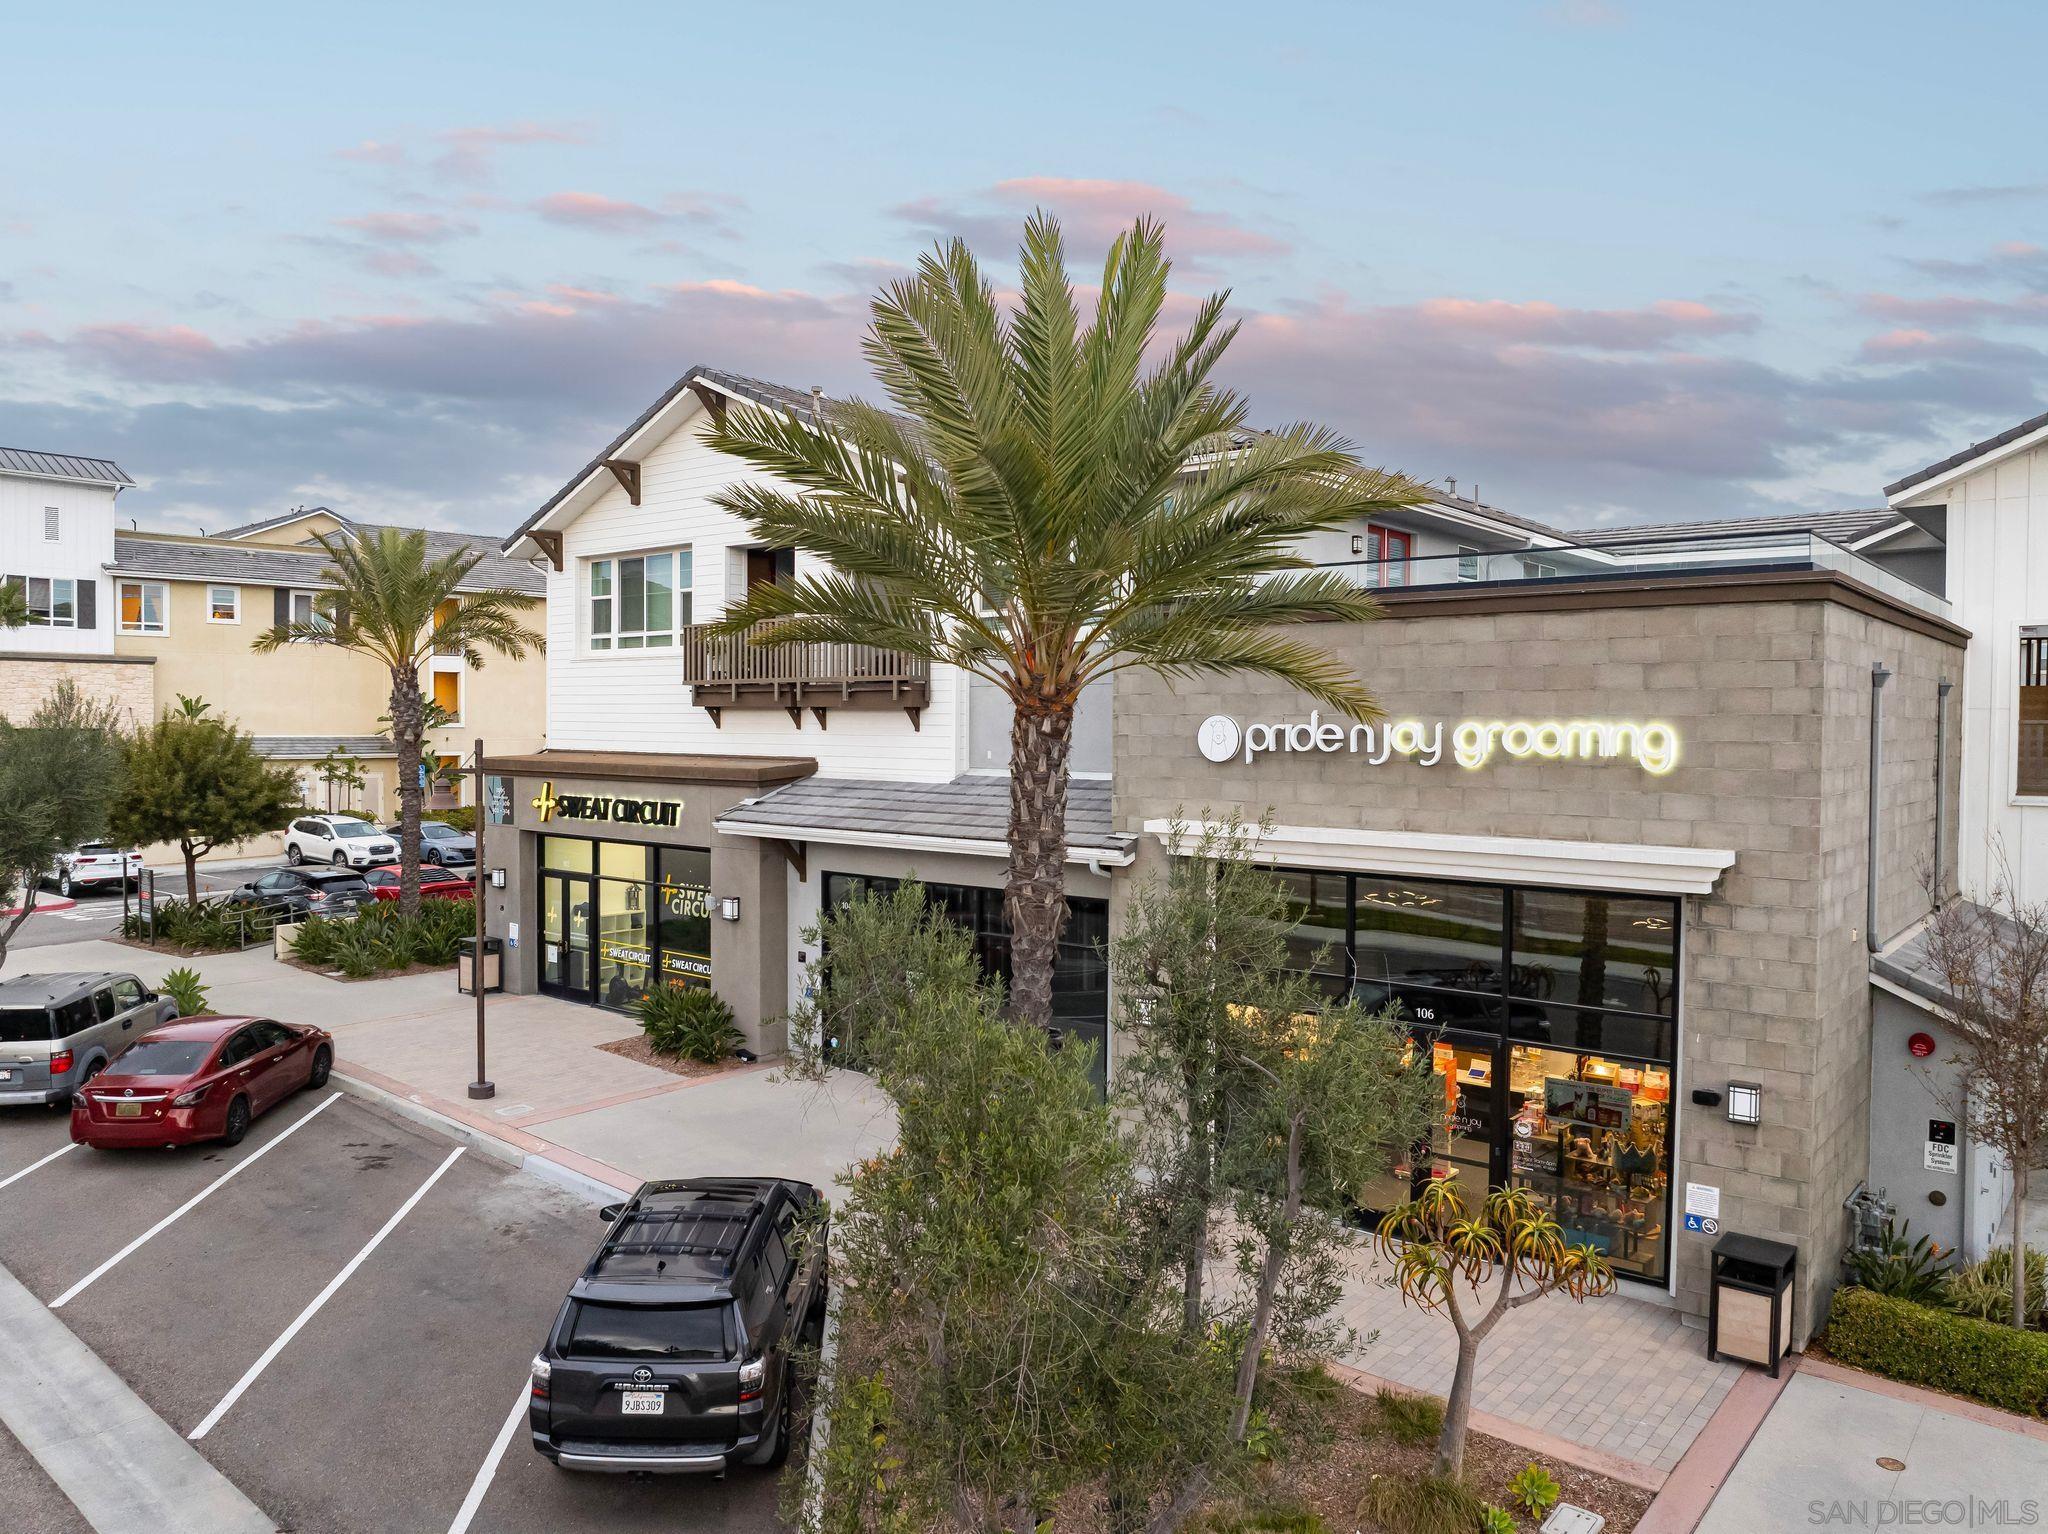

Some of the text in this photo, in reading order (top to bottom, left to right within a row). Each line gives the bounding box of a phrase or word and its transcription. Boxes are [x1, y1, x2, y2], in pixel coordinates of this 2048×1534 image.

[1245, 709, 1674, 773] pride n joy grooming
[557, 795, 681, 826] SWEAT CIRCUIT
[671, 898, 712, 919] CIRCU
[609, 947, 651, 963] SWEAT CIRCUIT
[671, 959, 692, 971] SWEAT
[1415, 1006, 1435, 1020] 106
[1467, 1118, 1482, 1129] joy
[1932, 1143, 1950, 1153] FDC
[1928, 1151, 1953, 1159] Sprinkler
[1930, 1158, 1951, 1166] System
[624, 1400, 662, 1411] 9JBS309
